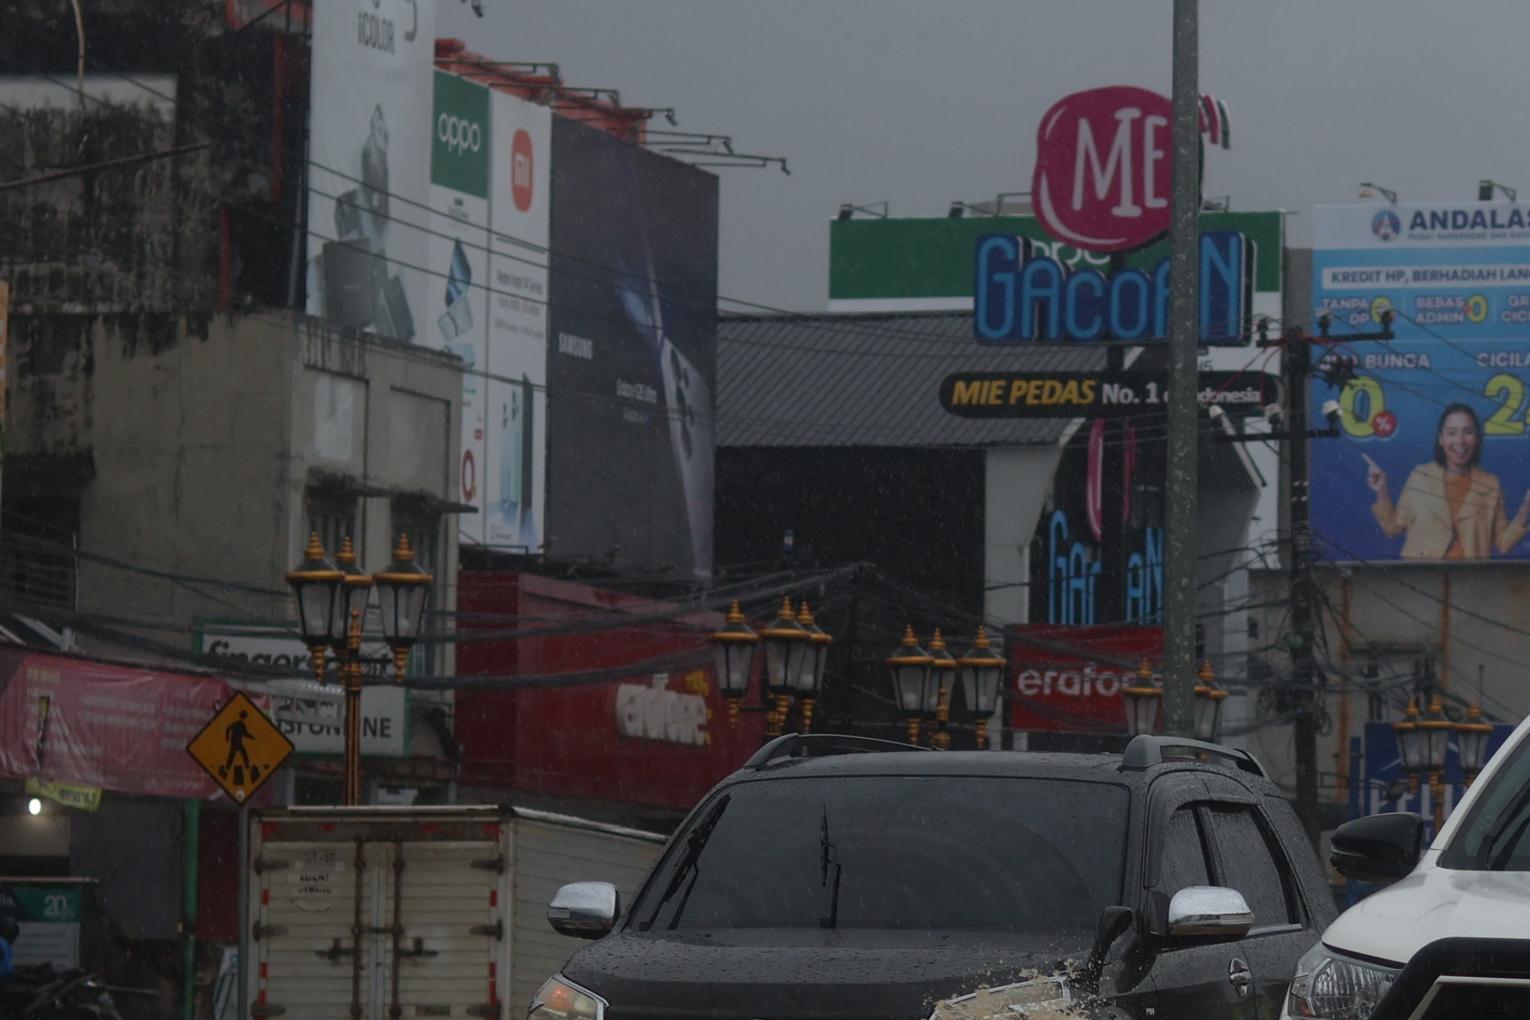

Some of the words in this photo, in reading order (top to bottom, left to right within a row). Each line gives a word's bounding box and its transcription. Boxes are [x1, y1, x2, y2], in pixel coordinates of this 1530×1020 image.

[438, 112, 481, 156] oppo
[1331, 270, 1383, 284] KREDIT
[1386, 269, 1410, 285] HP,
[1412, 269, 1497, 283] BERHADIAH
[1321, 298, 1370, 310] TANPA
[1415, 296, 1465, 309] BEBAS
[1349, 313, 1370, 325] DP
[1415, 311, 1465, 324] ADMIN
[1364, 353, 1430, 369] BUNGA
[951, 379, 1004, 406] MIE
[1009, 379, 1096, 406] PEDAS
[1102, 383, 1139, 405] No.
[1145, 382, 1160, 404] 1
